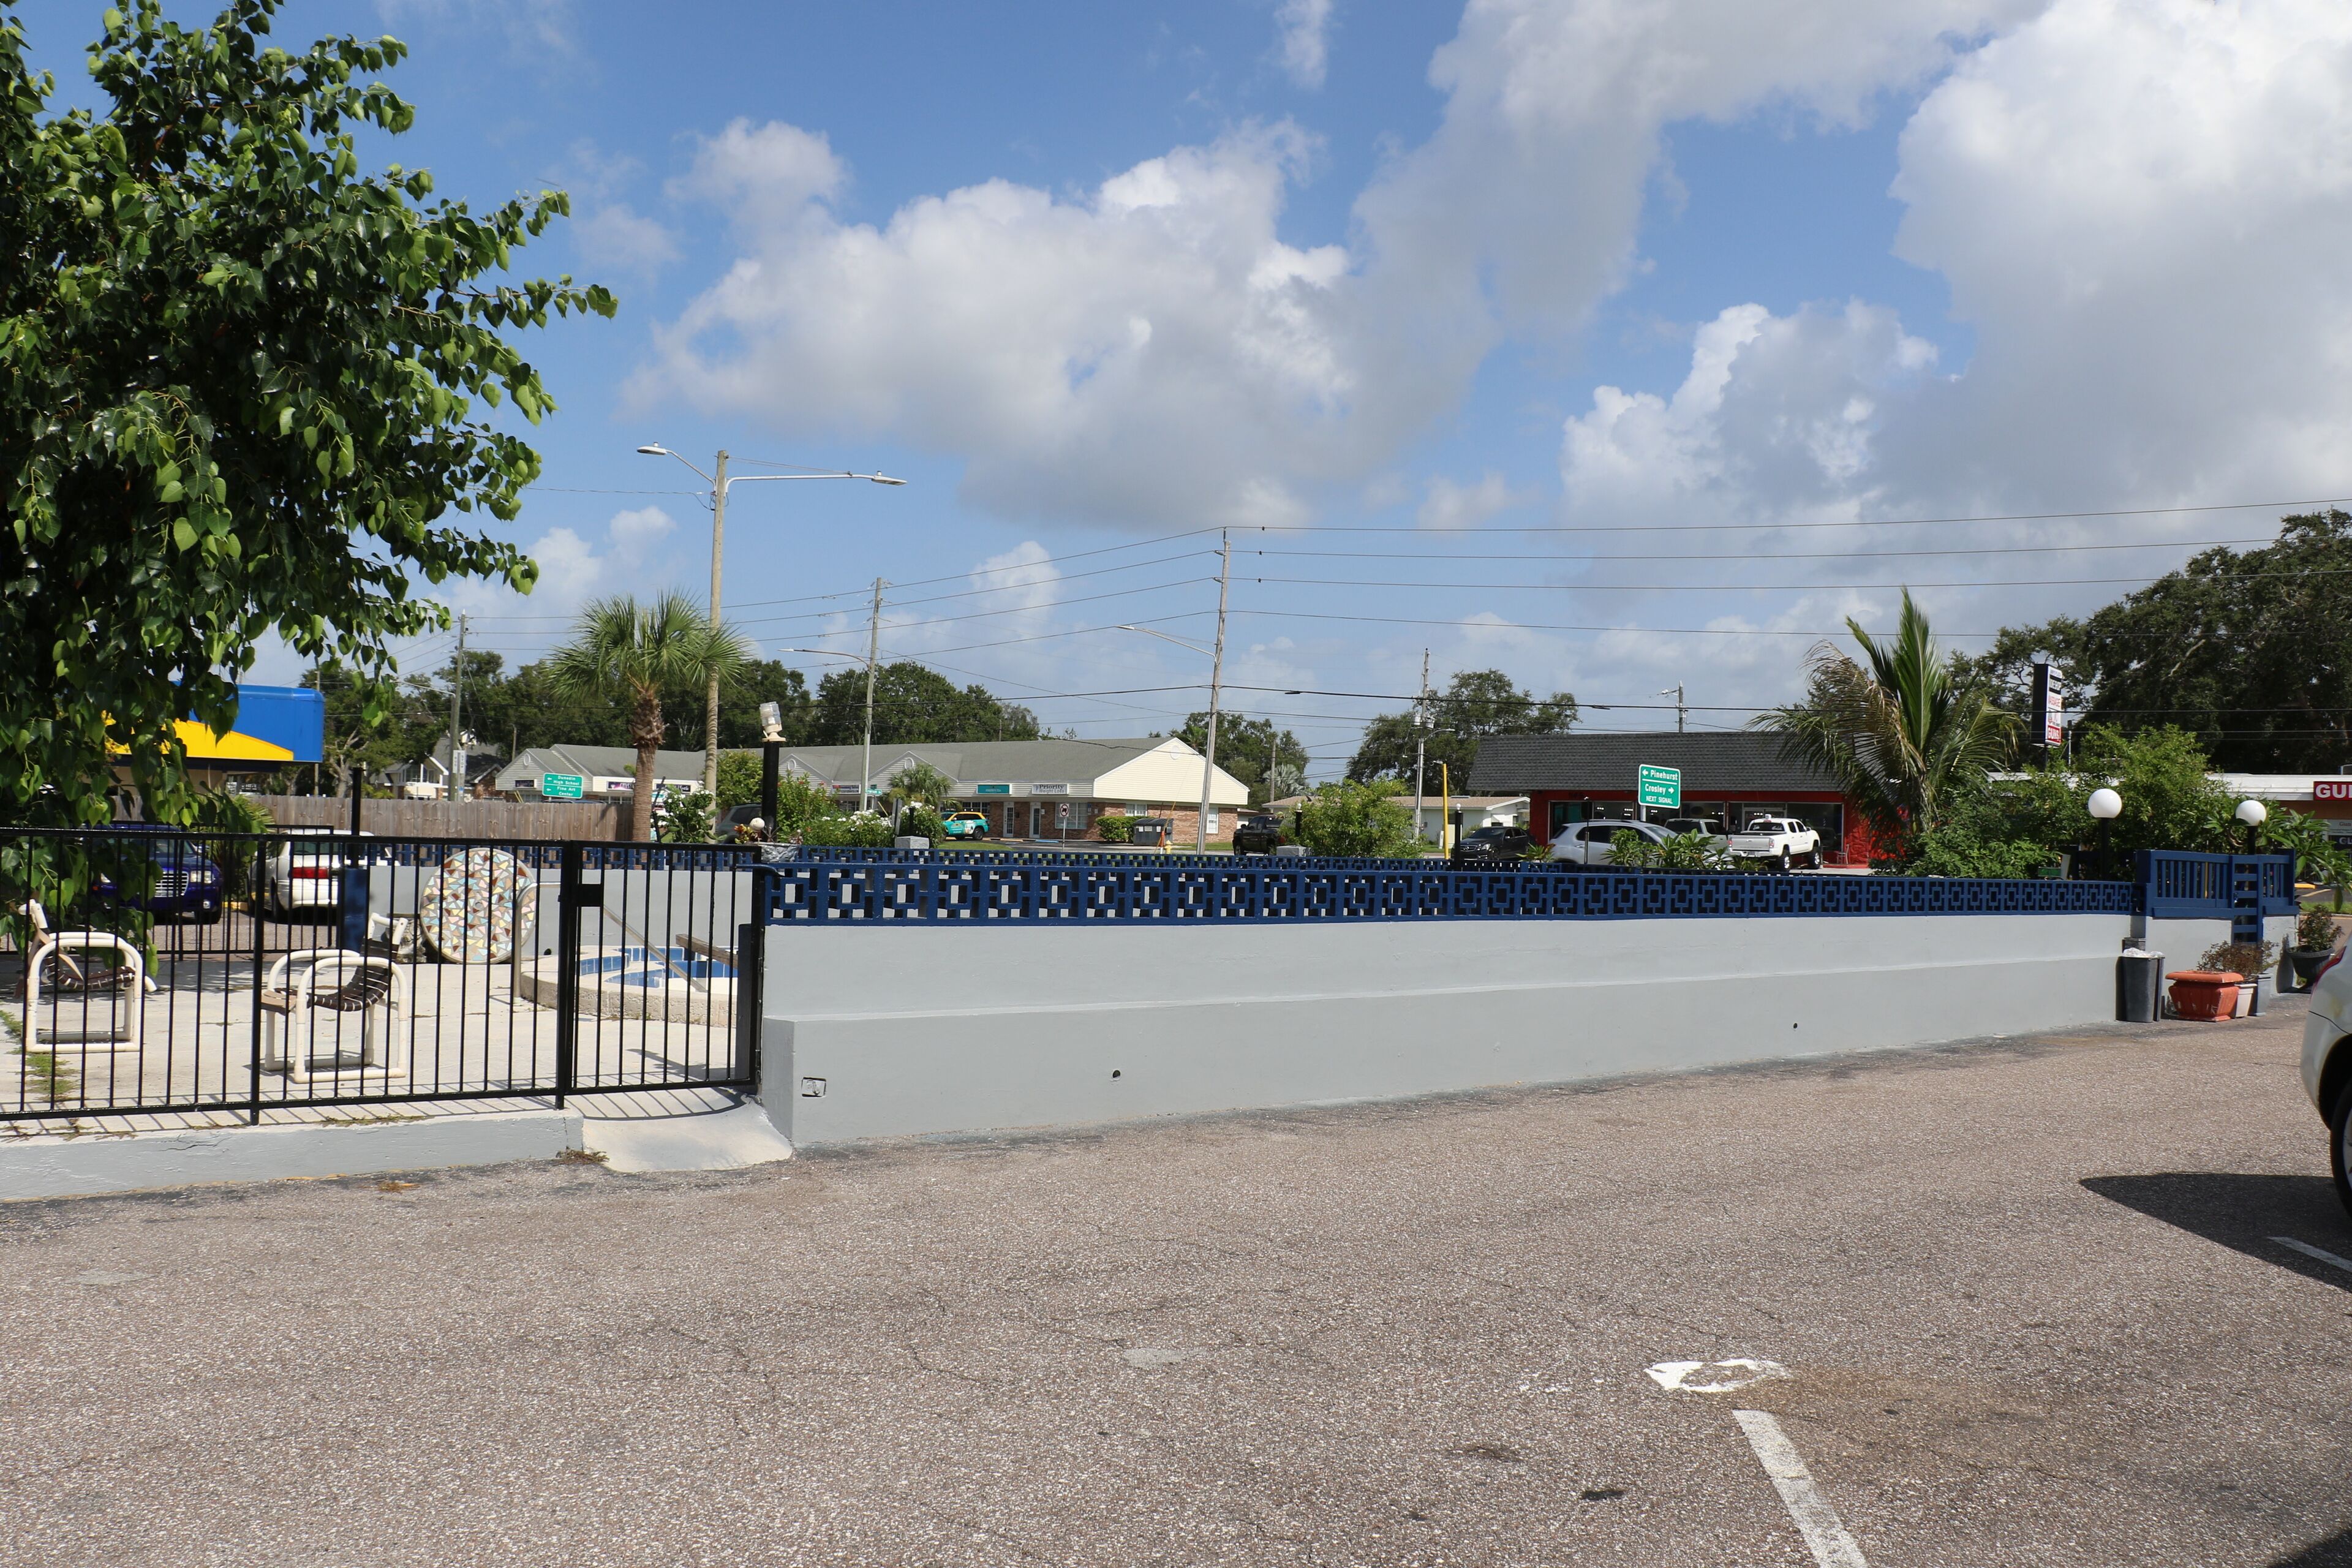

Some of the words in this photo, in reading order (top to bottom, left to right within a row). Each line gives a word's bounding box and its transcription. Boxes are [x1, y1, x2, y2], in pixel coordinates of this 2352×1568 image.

[1650, 769, 1678, 780] Pinehurst
[1645, 783, 1666, 795] Crosley
[2315, 784, 2352, 798] GU
